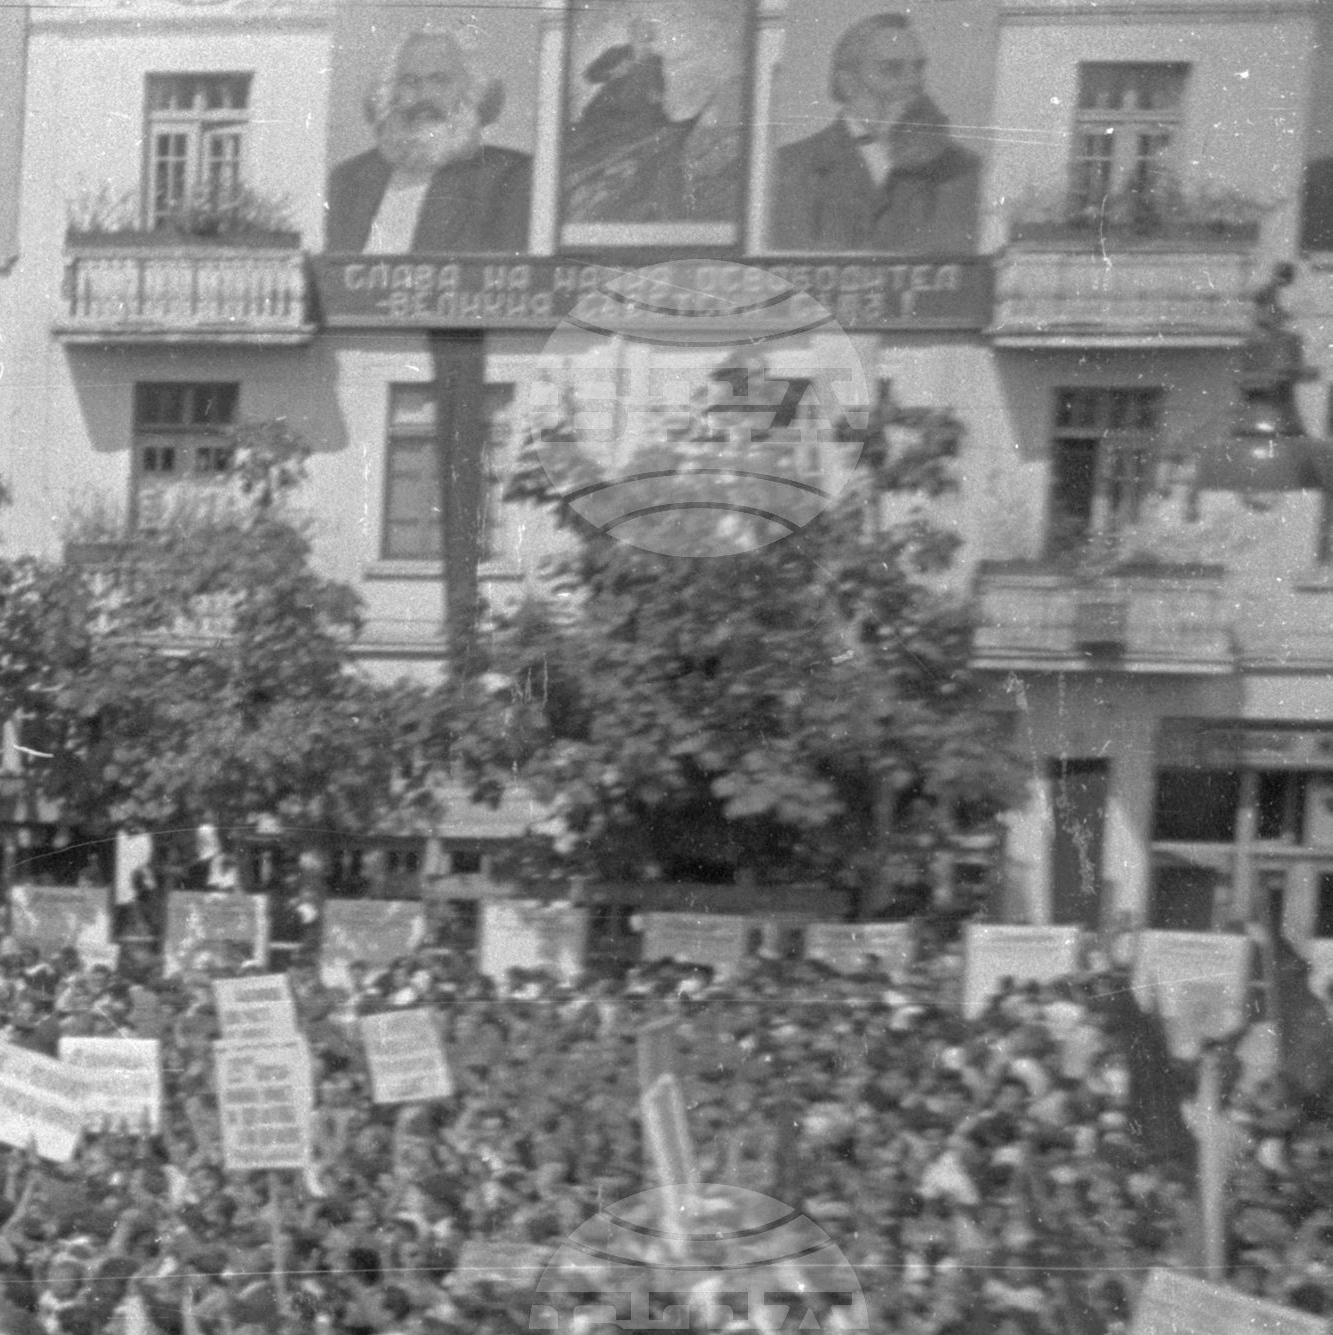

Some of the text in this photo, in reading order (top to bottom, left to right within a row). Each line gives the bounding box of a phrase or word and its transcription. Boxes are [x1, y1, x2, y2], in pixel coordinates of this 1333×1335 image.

[344, 263, 461, 291] СЛАВА
[483, 264, 531, 291] НА
[790, 290, 885, 317] СЮЗ
